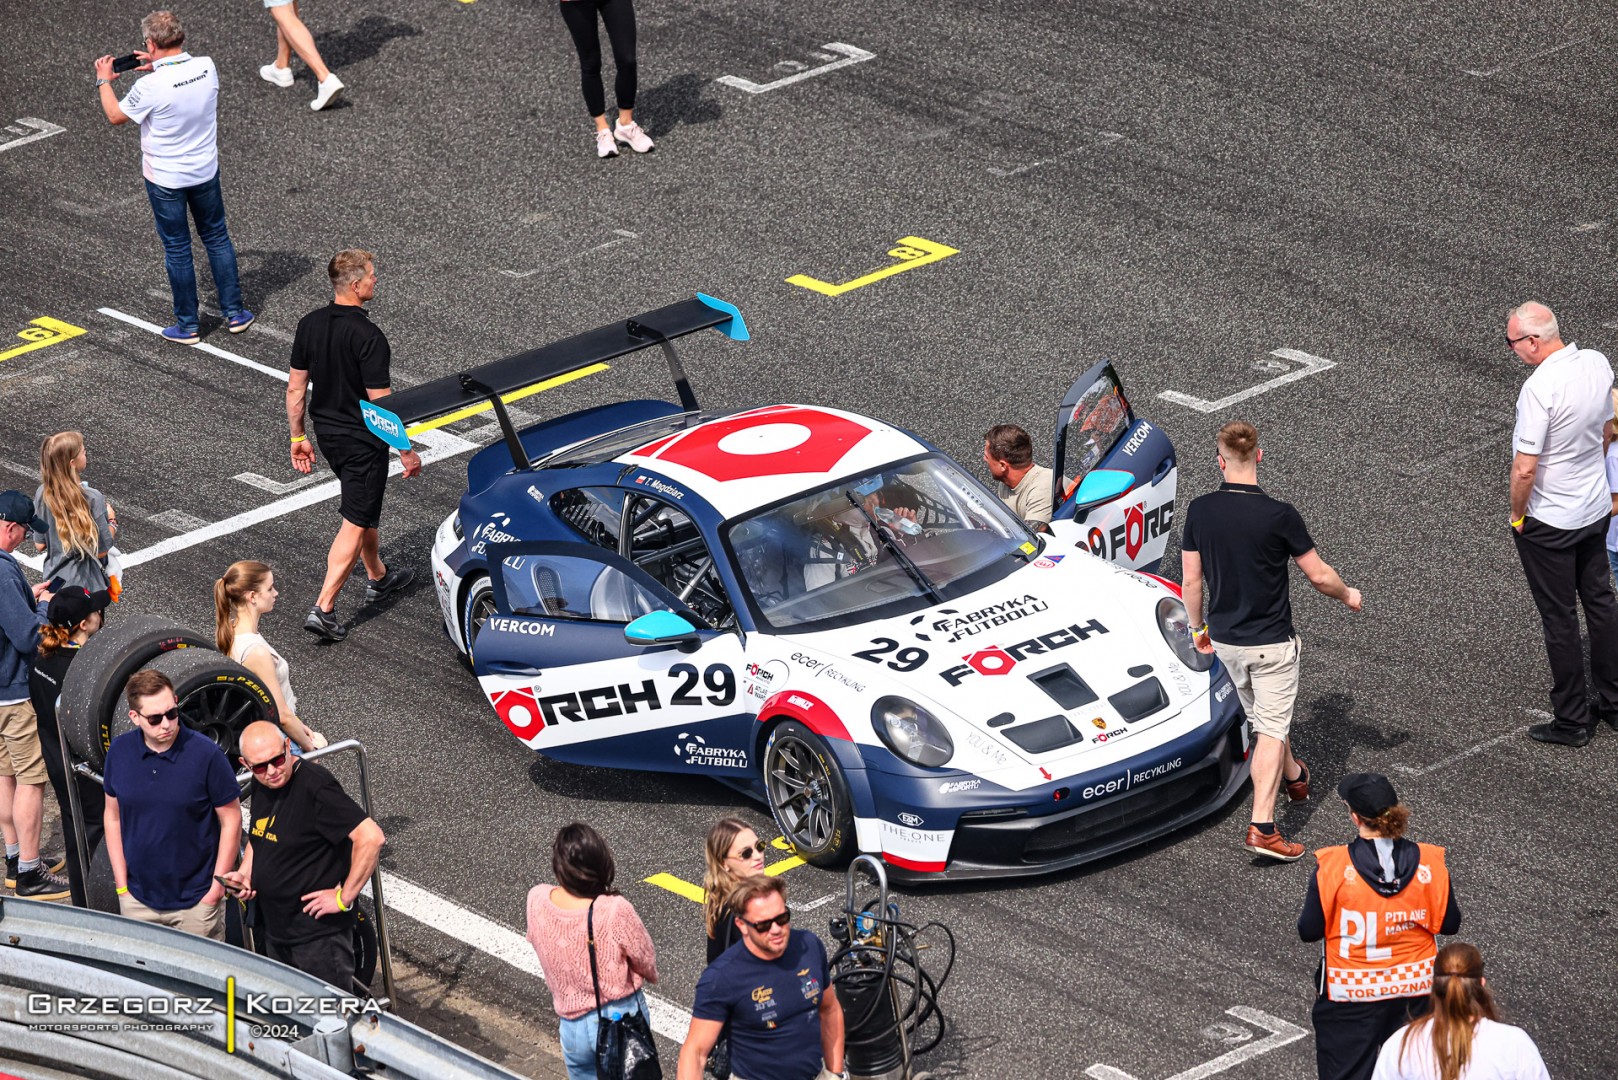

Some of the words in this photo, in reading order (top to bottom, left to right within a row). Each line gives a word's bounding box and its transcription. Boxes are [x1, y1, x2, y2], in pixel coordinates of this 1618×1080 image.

[172, 74, 207, 89] McLaren
[362, 408, 399, 437] FÖRCH
[1122, 421, 1153, 457] VERCOM
[644, 477, 653, 487] T.
[1109, 499, 1176, 562] FÖRC
[490, 617, 556, 637] VERCOM
[942, 594, 1039, 633] FABRYKA
[952, 600, 1049, 642] FUTBOLU
[851, 637, 930, 673] 29
[938, 618, 1111, 688] FÖRCH
[745, 662, 775, 682] FÖRCH
[790, 651, 825, 671] ecer
[824, 668, 867, 694] RECYKLING
[490, 678, 663, 742] ÖRCH
[667, 663, 737, 707] 29
[1091, 726, 1129, 744] FÖRCH
[687, 745, 747, 760] FABRYKA
[687, 755, 749, 769] FUTBOLU
[1082, 776, 1124, 800] ecer
[1132, 757, 1183, 785] RECYKLING
[1384, 909, 1428, 923] PITLANE
[1338, 907, 1393, 962] PL
[1345, 988, 1376, 999] TOR
